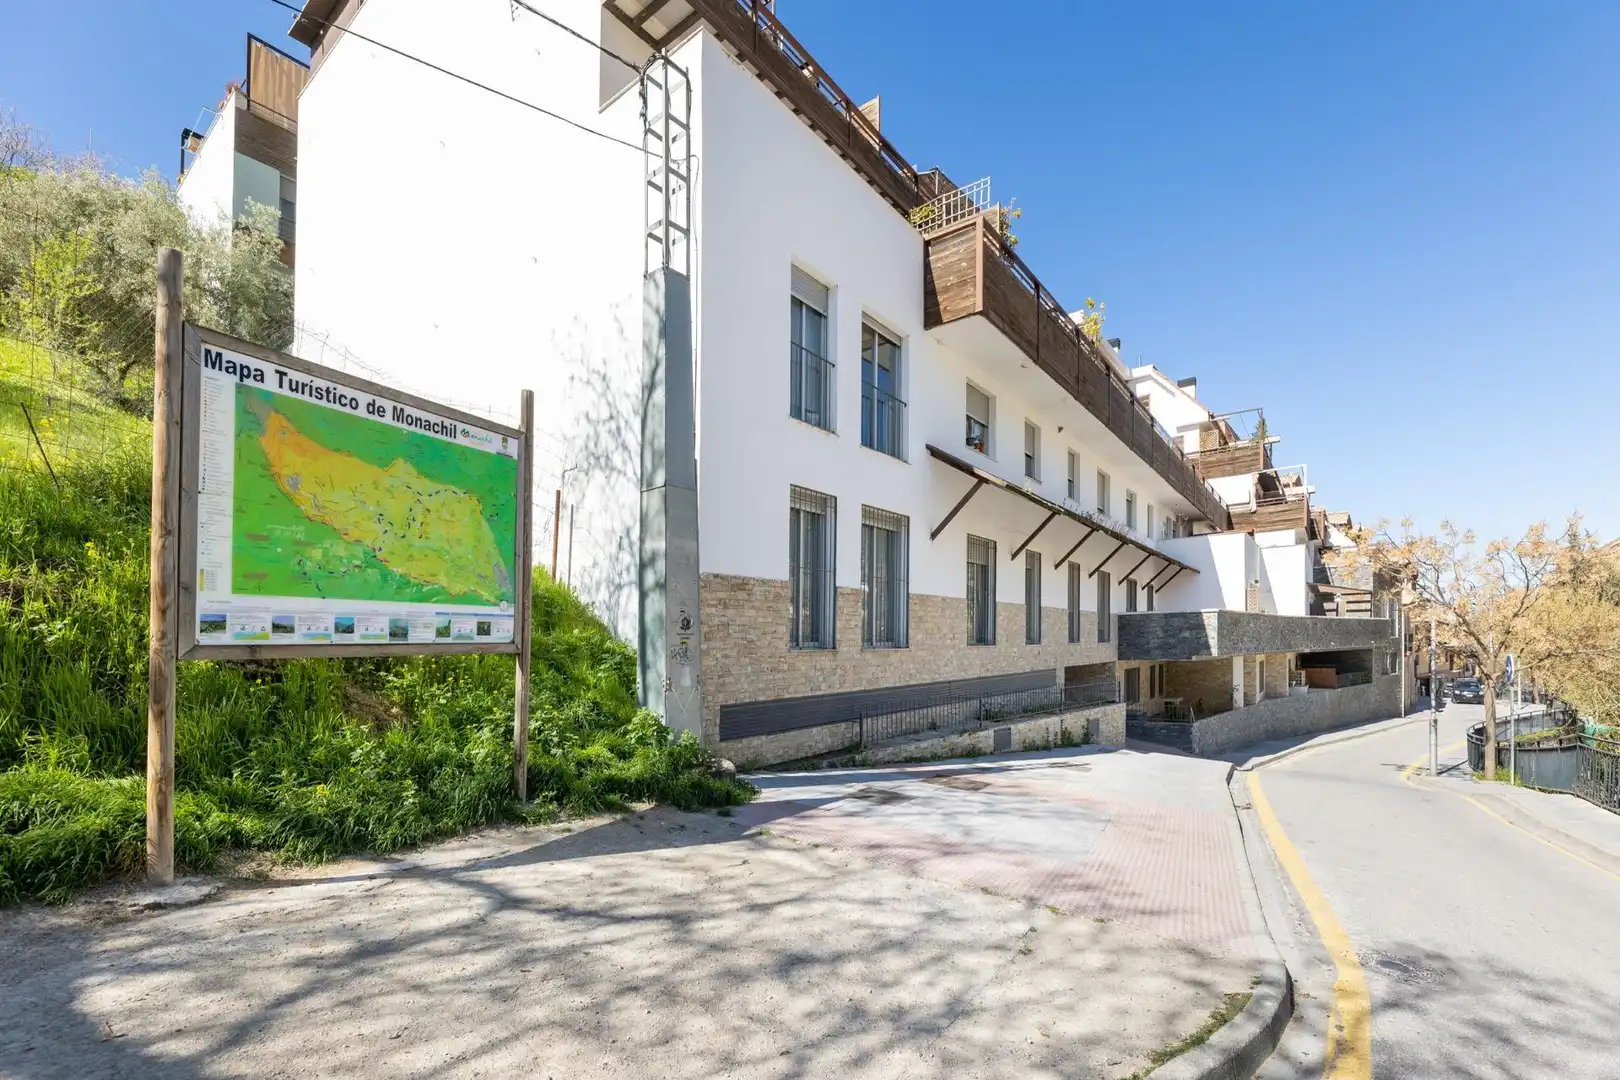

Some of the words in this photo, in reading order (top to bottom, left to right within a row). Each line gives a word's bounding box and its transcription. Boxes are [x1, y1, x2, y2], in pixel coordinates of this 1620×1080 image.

[204, 348, 264, 382] Mapa
[274, 369, 359, 410] Turístico
[366, 399, 386, 418] de
[392, 405, 457, 439] Monachil
